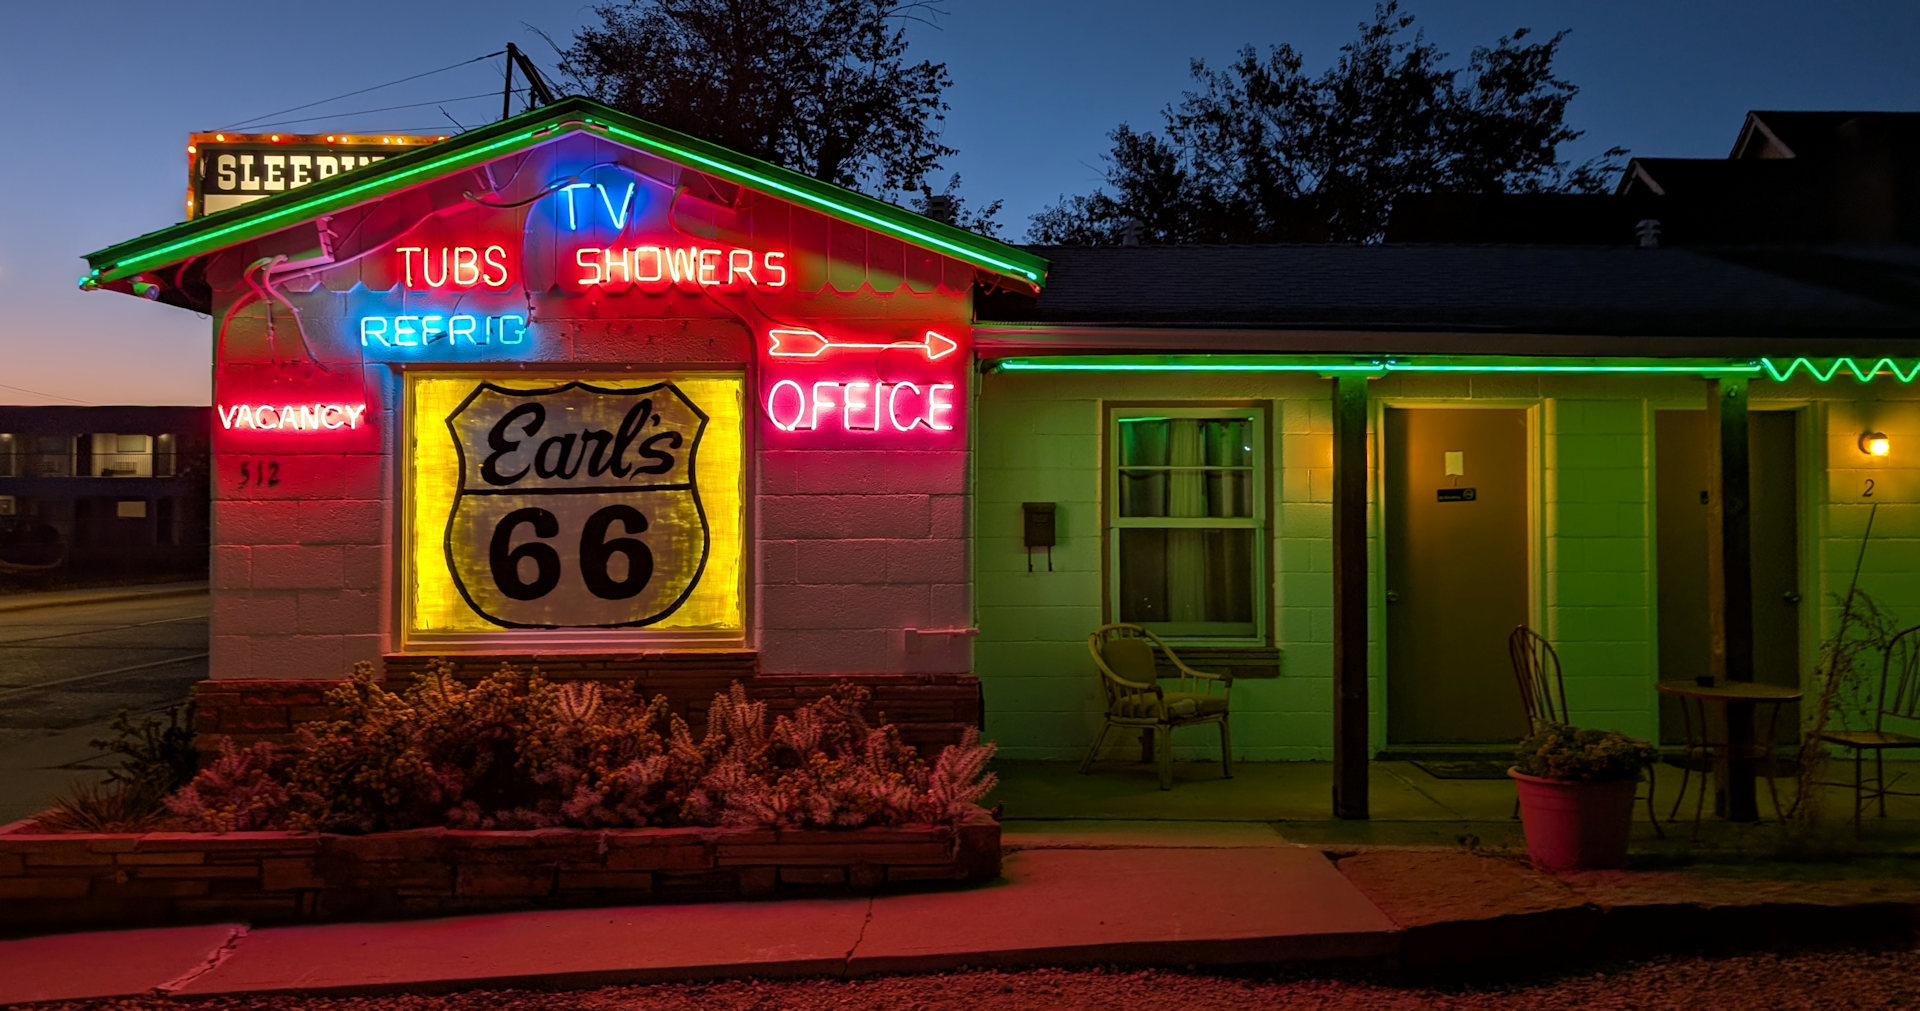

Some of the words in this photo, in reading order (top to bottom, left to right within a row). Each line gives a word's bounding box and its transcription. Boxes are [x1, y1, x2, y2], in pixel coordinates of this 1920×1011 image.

[217, 154, 385, 191] SLEEP
[552, 183, 635, 231] TV
[396, 245, 508, 287] TUBS
[576, 245, 787, 287] SHOWERS
[360, 315, 526, 347] REFRIG
[218, 403, 366, 430] VACANCY
[767, 379, 954, 432] OFFICE
[480, 397, 684, 486] Earl's
[238, 460, 281, 489] 512
[1862, 478, 1875, 498] 2
[489, 504, 654, 600] 66
